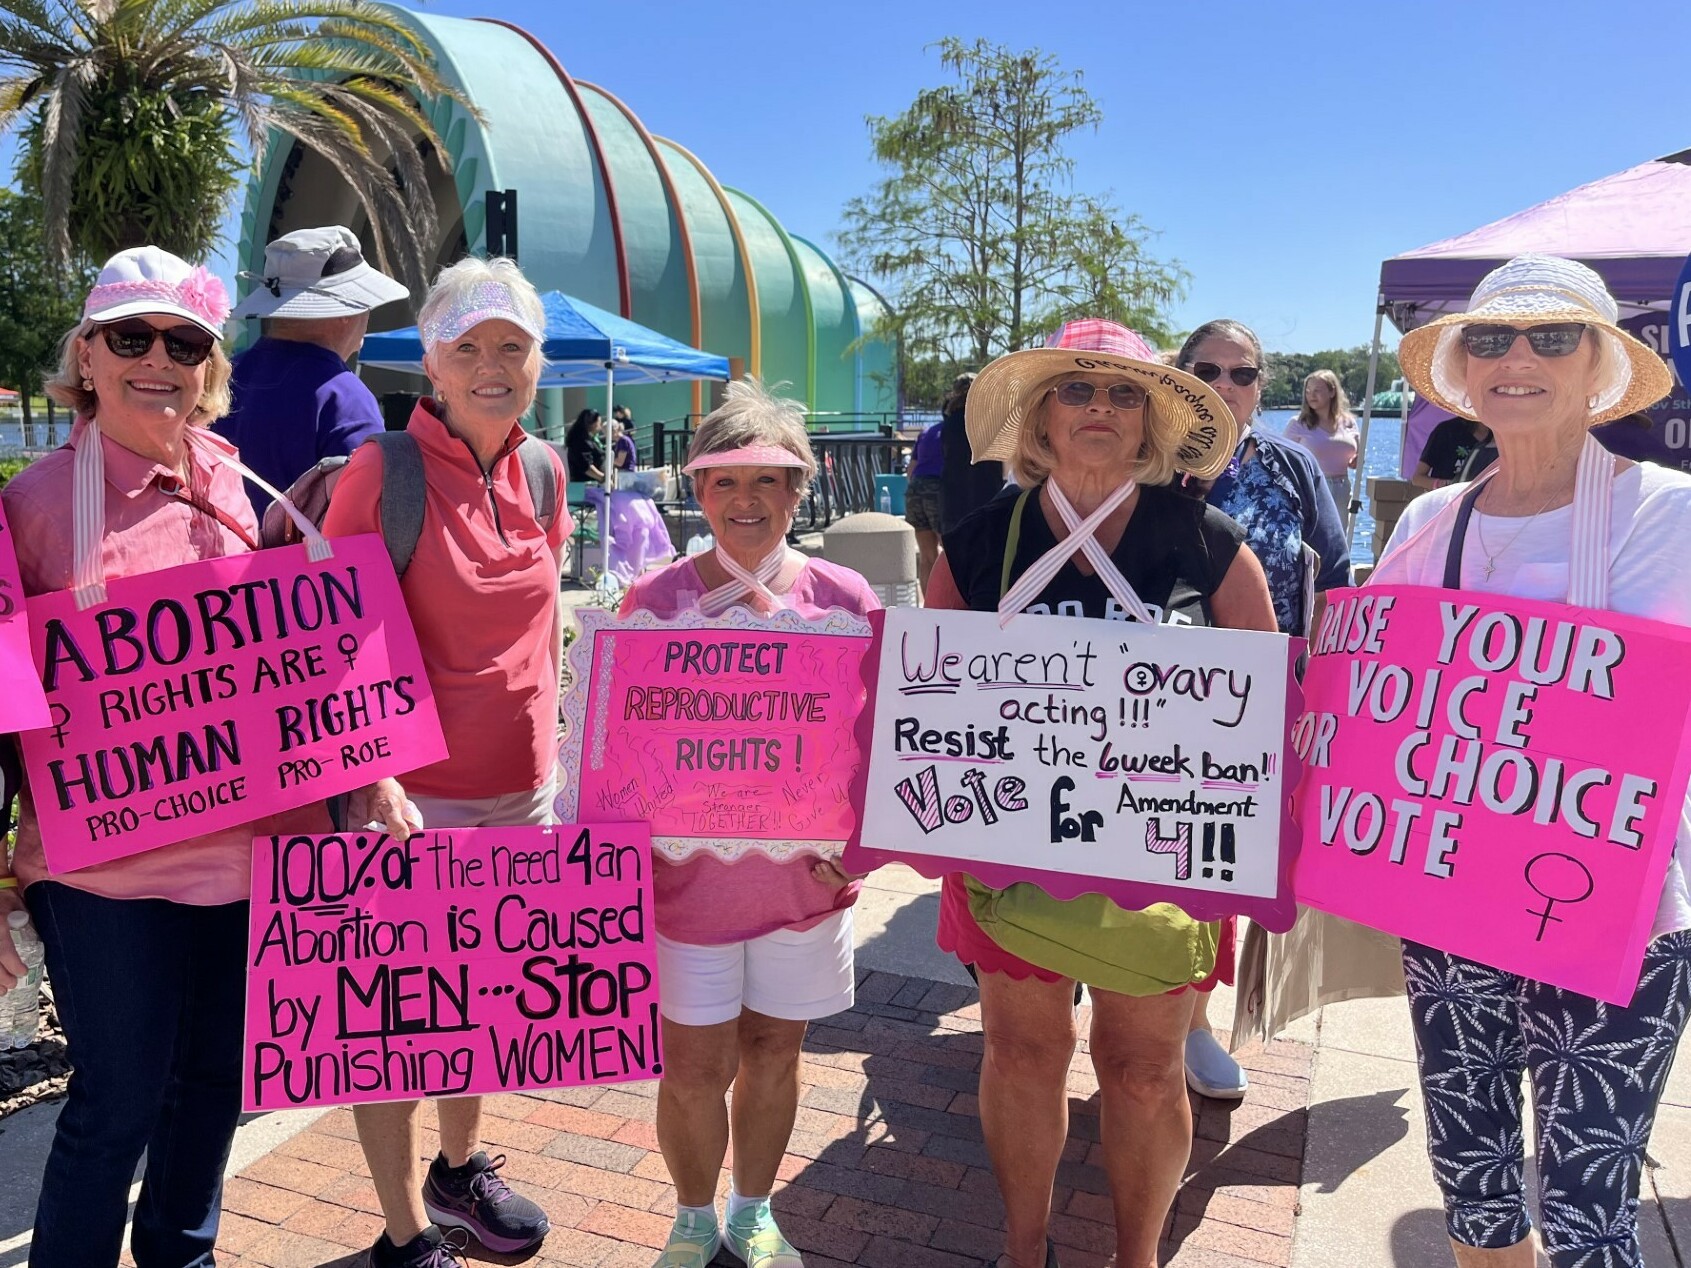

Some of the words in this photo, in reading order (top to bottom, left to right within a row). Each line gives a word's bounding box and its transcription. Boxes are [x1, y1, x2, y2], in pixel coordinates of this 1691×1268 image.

[42, 566, 364, 693] ABORTION
[664, 641, 788, 675] PROTECT
[901, 624, 961, 683] We
[967, 640, 1098, 687] aren't
[1436, 601, 1626, 701] YOUR
[100, 664, 238, 729] RIGHTS
[252, 645, 327, 693] ARE
[624, 686, 830, 722] REPRODUCTIVE
[1348, 659, 1538, 749] VOICE
[47, 720, 242, 810] HUMAN
[275, 675, 416, 752] RIGHTS
[894, 717, 1015, 761] Resist
[1033, 734, 1088, 768] the
[85, 776, 248, 842] PRO-CHOICE
[597, 778, 640, 812] Women
[708, 784, 727, 797] We
[737, 789, 760, 797] are
[782, 772, 823, 806] Never
[789, 807, 825, 832] Give
[894, 765, 1029, 835] Vote
[1116, 783, 1258, 818] Amendment
[1395, 731, 1658, 852] CHOICE
[427, 833, 485, 890] the
[492, 833, 560, 888] need
[566, 828, 592, 886] 4
[595, 841, 641, 882] an
[1320, 784, 1464, 880] VOTE
[254, 908, 428, 967] Abortion
[447, 905, 481, 952] is
[495, 888, 644, 953] Caused
[268, 978, 321, 1051] by
[254, 1036, 473, 1106] Punishing
[488, 1003, 663, 1088] WOMEN!
